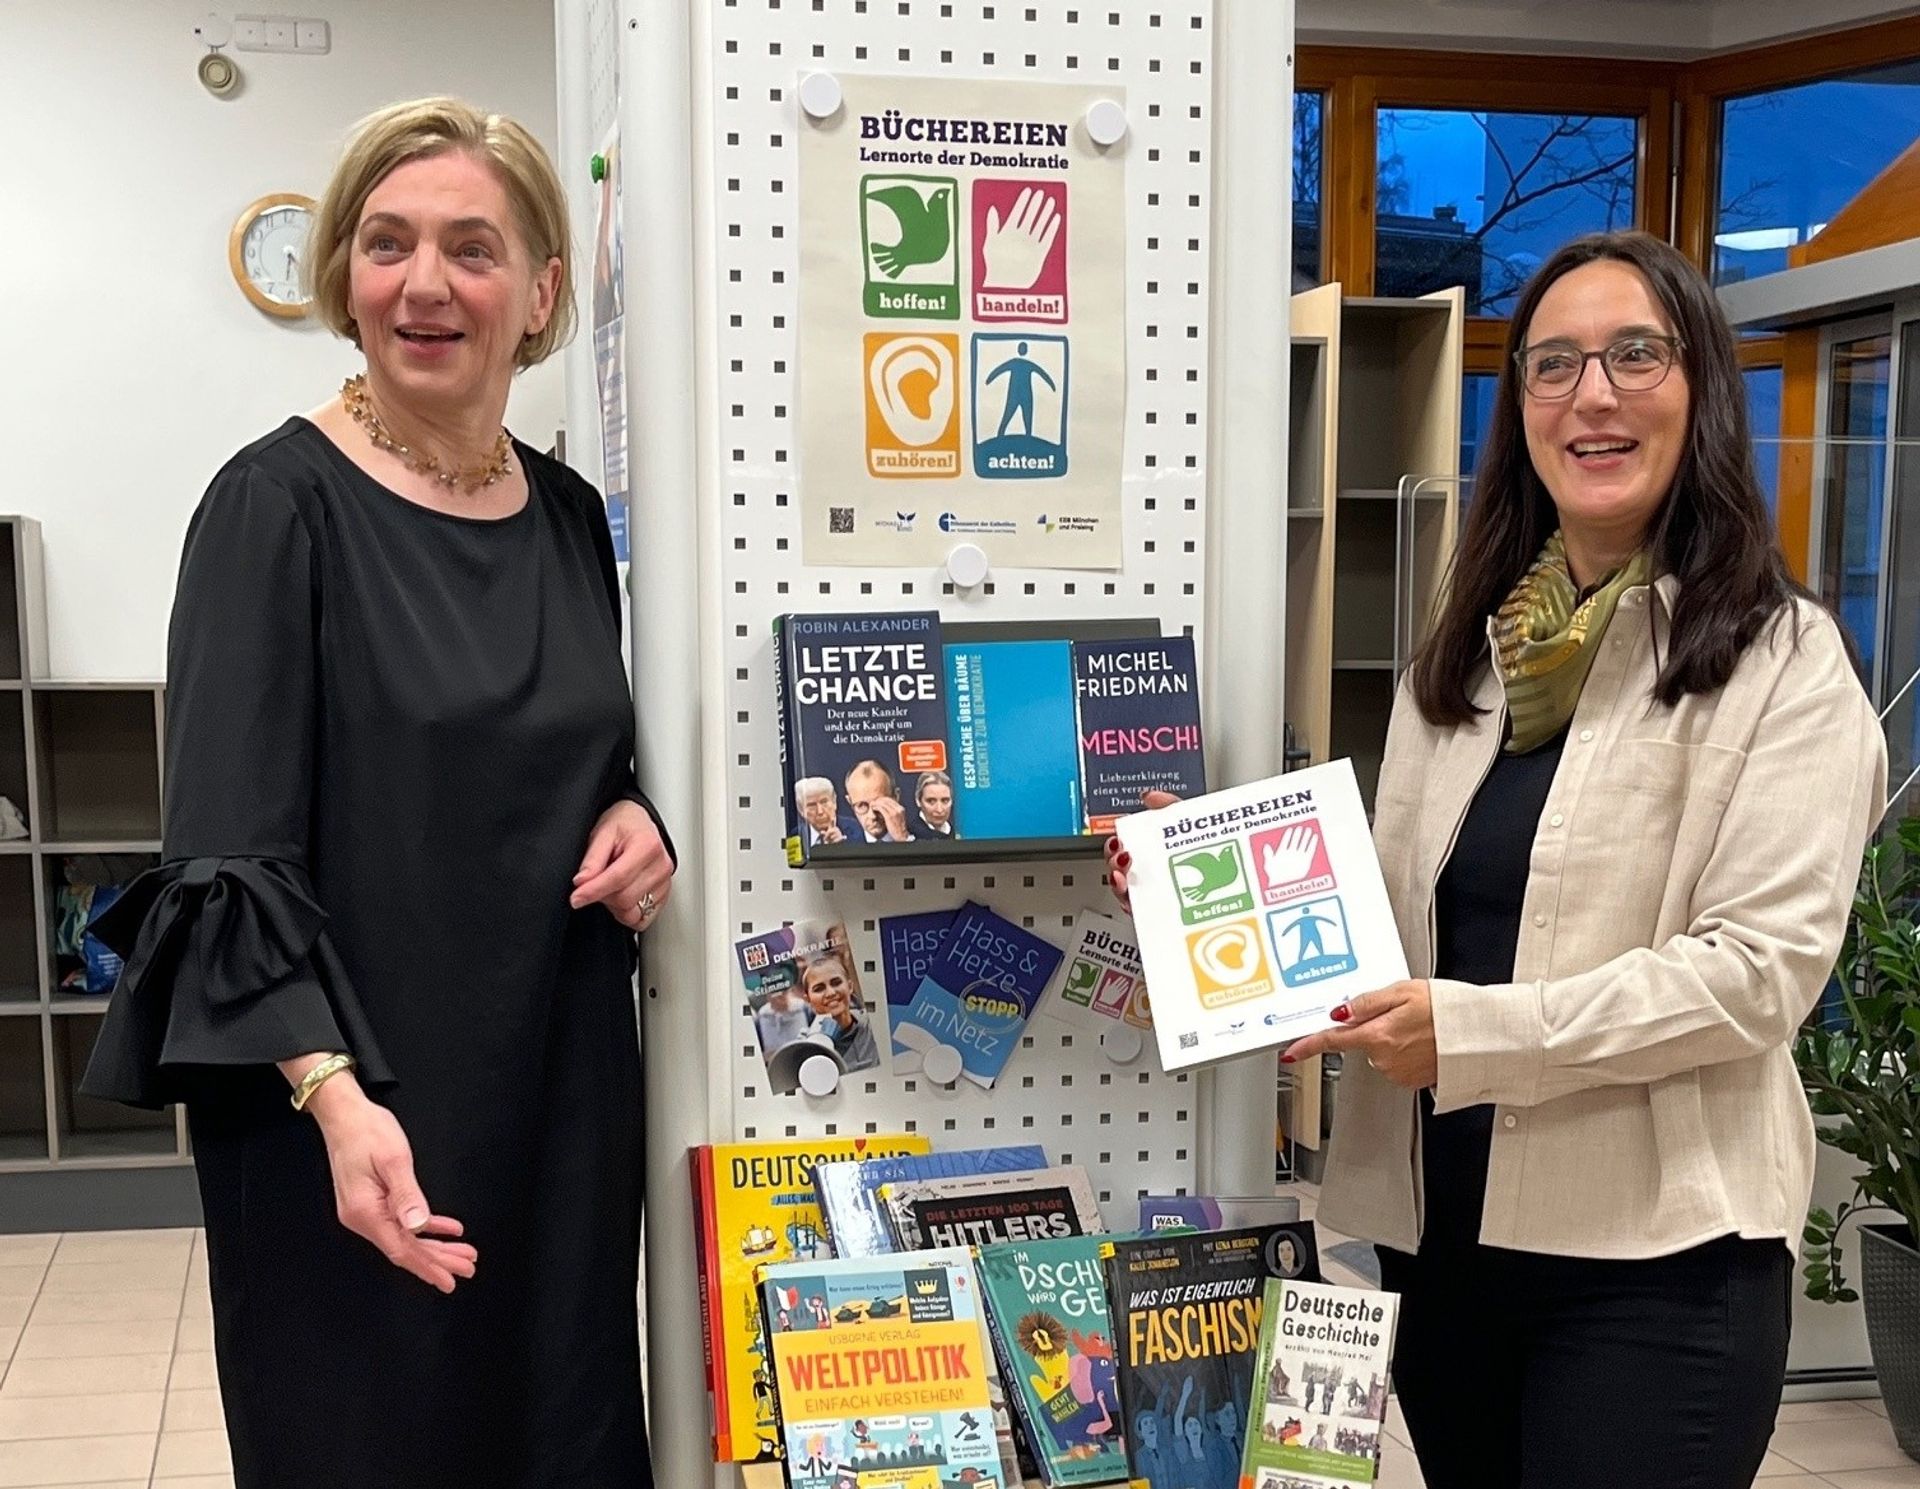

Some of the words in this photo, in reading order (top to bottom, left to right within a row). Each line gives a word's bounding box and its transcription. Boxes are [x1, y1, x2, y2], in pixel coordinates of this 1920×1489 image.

[860, 110, 1068, 147] BÜCHEREIEN
[860, 147, 933, 164] Lernorte
[937, 150, 965, 166] der
[970, 152, 1069, 169] Demokratie
[879, 293, 946, 311] hoffen!
[982, 297, 1060, 314] handeln!
[876, 452, 953, 468] zuhören!
[988, 453, 1054, 470] achten!
[793, 621, 838, 634] ROBIN
[842, 618, 930, 633] ALEXANDER
[802, 644, 926, 674] LETZTE
[1088, 651, 1174, 674] MICHEL
[954, 654, 970, 692] BÄUME
[969, 654, 985, 715] DEMOKRATIE
[795, 674, 937, 704] CHANCE
[1077, 674, 1188, 698] FRIEDMAN
[827, 708, 845, 719] Der
[848, 709, 869, 718] neue
[871, 706, 908, 718] Kanzler
[957, 694, 972, 723] ÜBER
[824, 721, 843, 731] und
[845, 721, 860, 730] der
[863, 719, 895, 731] Kampf
[897, 721, 912, 729] um
[974, 718, 987, 738] ZUR
[833, 734, 848, 744] die
[850, 732, 905, 743] Demokratie
[1082, 725, 1199, 756] MENSCH!
[960, 725, 977, 789] GESPRÄCHE
[975, 740, 991, 789] GEDICHTE
[1100, 770, 1180, 784] Liebeserklärung
[1093, 785, 1119, 796] eines
[1111, 796, 1144, 808] Demo
[1162, 790, 1313, 839] BÜCHEREIEN
[1165, 831, 1217, 850] Lernorte
[1221, 825, 1241, 836] der
[1244, 805, 1318, 829] Demokratie
[1270, 878, 1329, 900] handeln!
[959, 915, 1018, 963] Hass
[1019, 949, 1039, 975] &
[947, 940, 1017, 993] Hetze
[1079, 945, 1121, 968] Lernorte
[1123, 962, 1140, 974] der
[754, 980, 791, 997] Stimme
[965, 995, 1019, 1018] STOPP
[915, 996, 945, 1028] im
[946, 1013, 1000, 1056] Netz
[926, 1210, 948, 1222] DIE
[950, 1206, 1005, 1220] LETZTEN
[1008, 1203, 1030, 1214] 100
[1034, 1199, 1065, 1211] TAGE
[1155, 1216, 1180, 1225] WAS
[929, 1212, 1072, 1248] HITLERS
[1060, 1287, 1107, 1317] GE
[1129, 1290, 1158, 1309] WAS
[1161, 1286, 1183, 1304] IST
[1183, 1277, 1257, 1301] EIGENTLICH
[1285, 1290, 1384, 1323] Deutsche
[828, 1331, 877, 1345] USBORNE
[879, 1329, 921, 1342] VERLAG
[1282, 1317, 1380, 1347] Geschichte
[1328, 1347, 1357, 1359] Manfred
[786, 1344, 971, 1392] WELTPOLITIK
[805, 1395, 871, 1413] EINFACH
[874, 1388, 966, 1407] VERSTEHEN!
